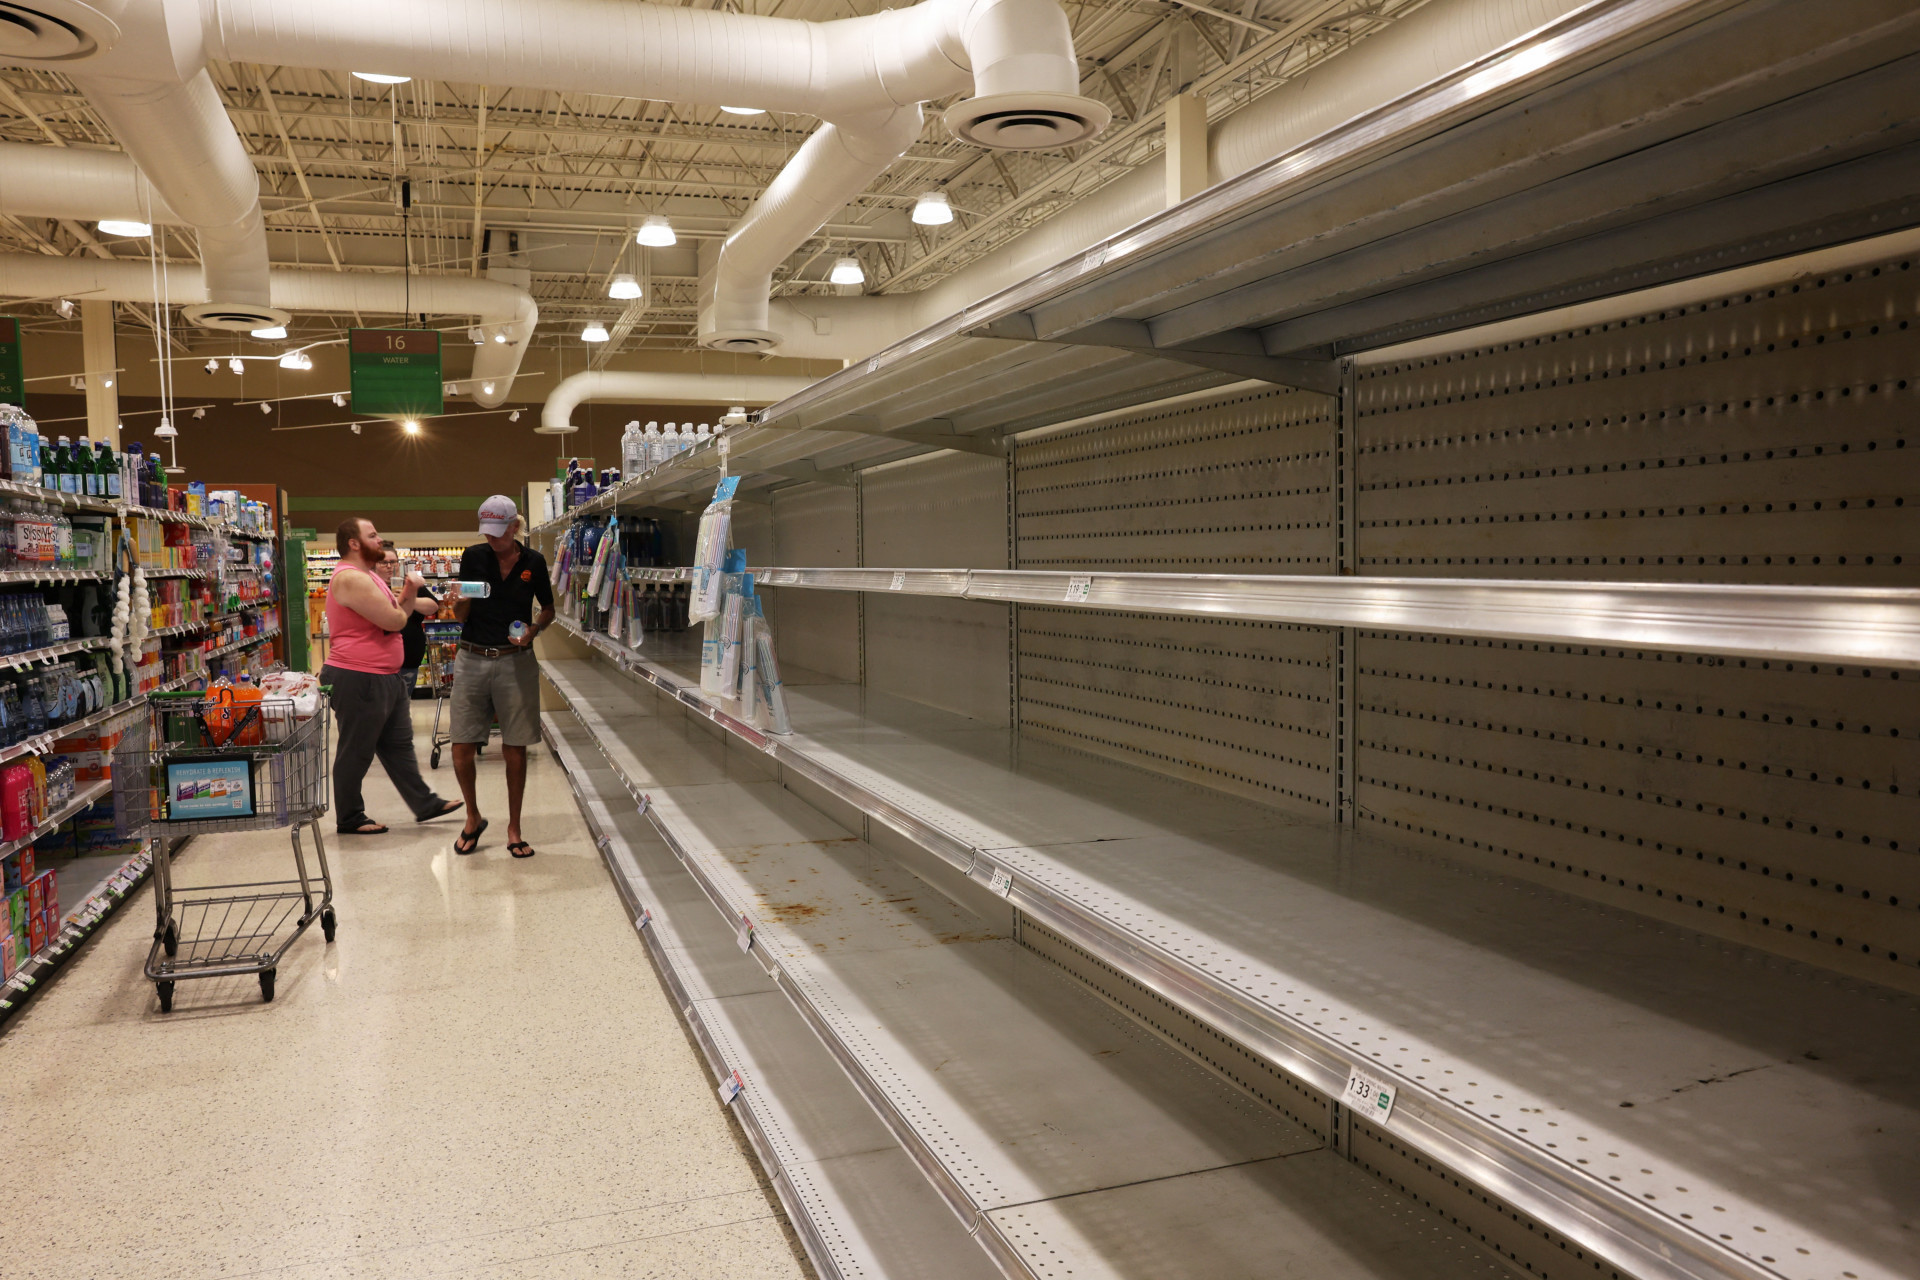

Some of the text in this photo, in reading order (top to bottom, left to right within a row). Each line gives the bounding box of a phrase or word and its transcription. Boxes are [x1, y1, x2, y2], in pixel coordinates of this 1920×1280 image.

[385, 335, 406, 351] 16
[383, 356, 409, 365] WATER
[175, 767, 206, 776] REHYDRATE
[212, 766, 241, 775] REPLENISH
[1349, 1077, 1370, 1099] 1.33
